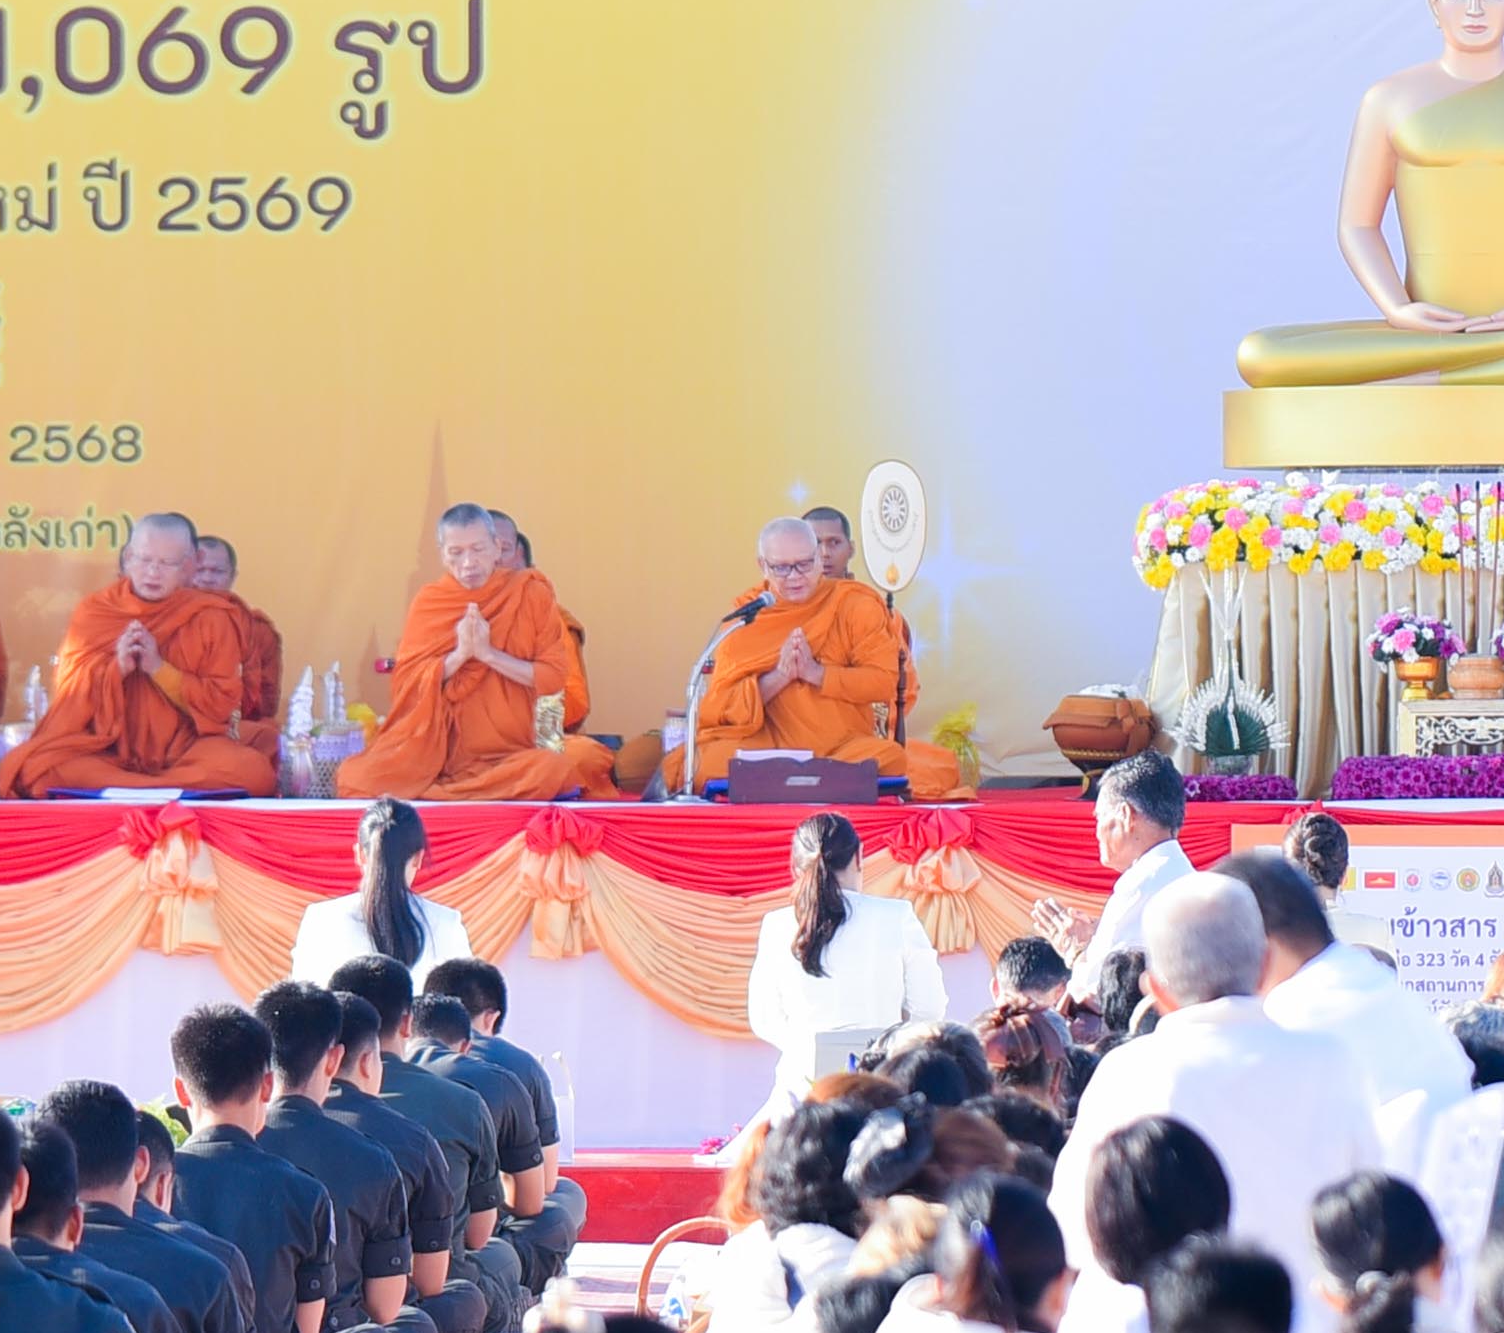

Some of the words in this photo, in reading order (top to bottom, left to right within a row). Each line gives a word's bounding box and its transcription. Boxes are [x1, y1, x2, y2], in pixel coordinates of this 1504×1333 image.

[82, 158, 129, 232] ปี
[156, 176, 353, 233] 2569
[9, 424, 143, 463] 2568
[1391, 906, 1497, 939] ข้าวสาร
[1416, 953, 1446, 968] 323
[1450, 948, 1470, 968] วัด
[1474, 953, 1485, 968] 4
